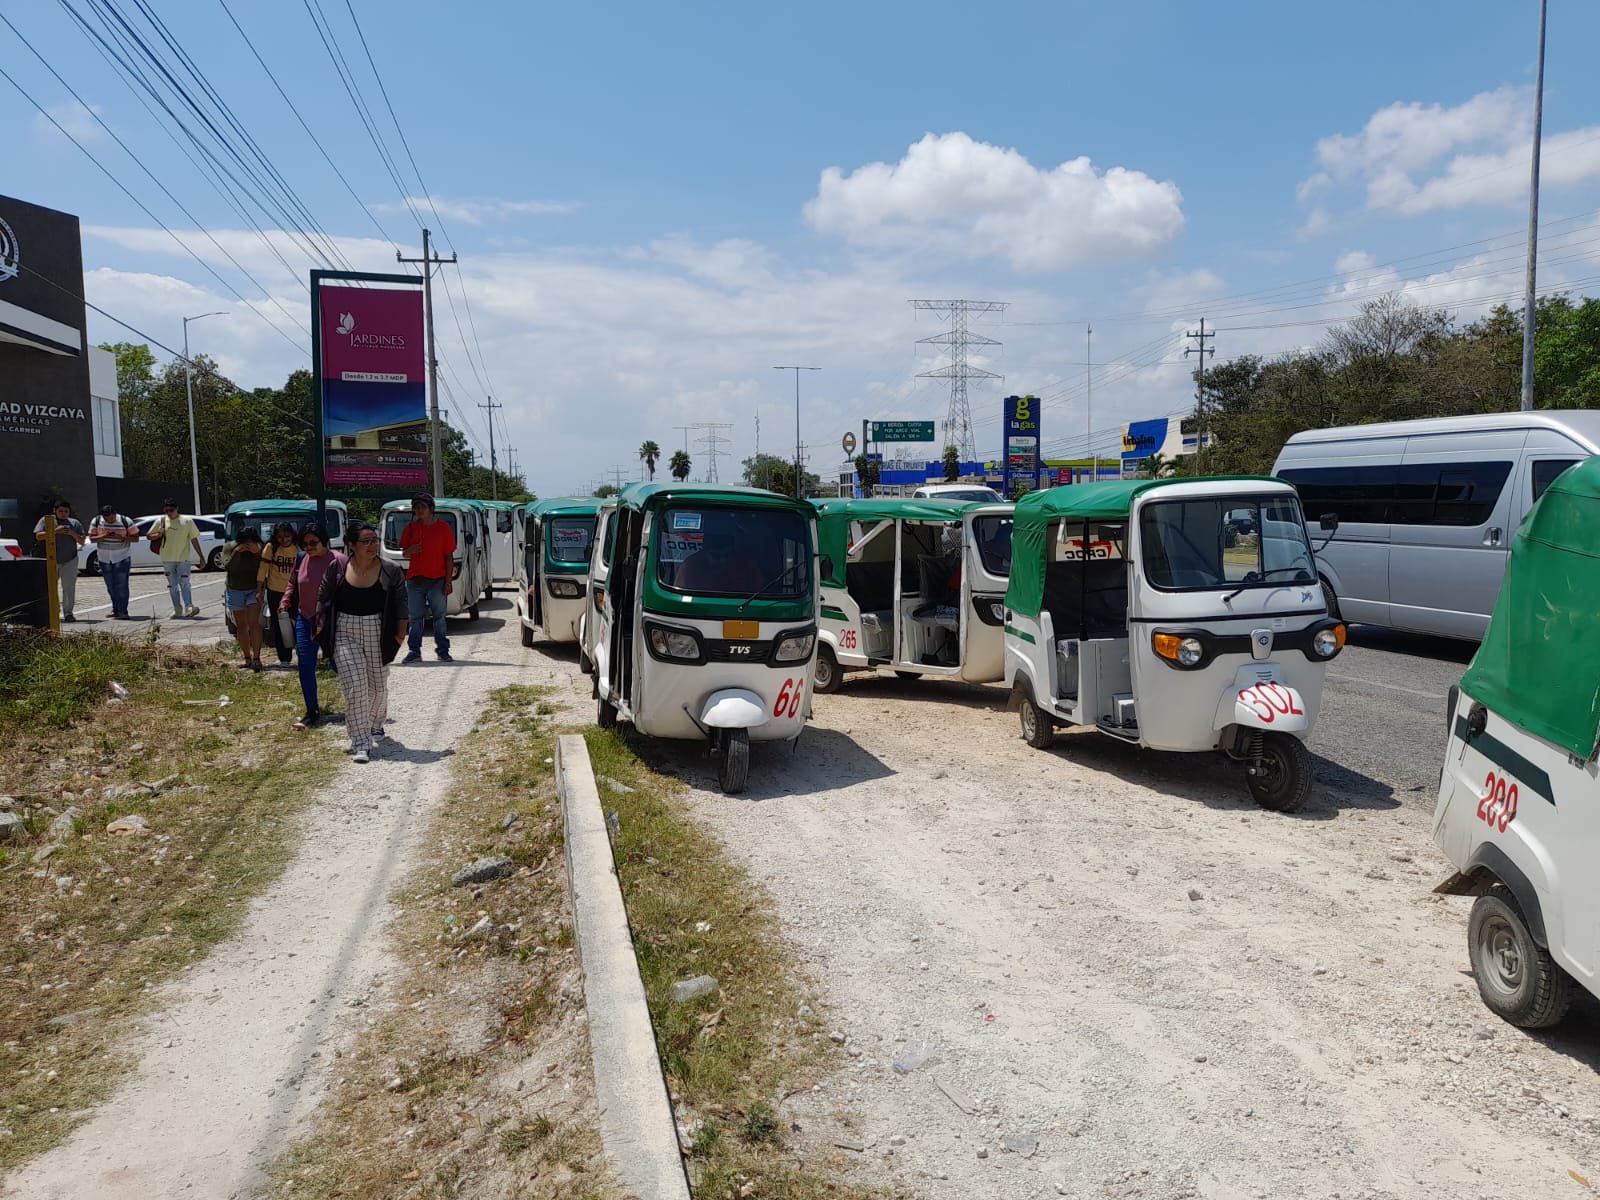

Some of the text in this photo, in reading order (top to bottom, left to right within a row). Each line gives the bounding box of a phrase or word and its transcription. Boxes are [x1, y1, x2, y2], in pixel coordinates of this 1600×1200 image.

[350, 333, 405, 347] JARDINES
[0, 401, 86, 420] AD VIZCAYA
[8, 426, 41, 434] CARMEN
[838, 628, 857, 649] 265
[729, 645, 751, 655] TVS
[773, 677, 804, 719] 66
[1238, 680, 1304, 723] 302
